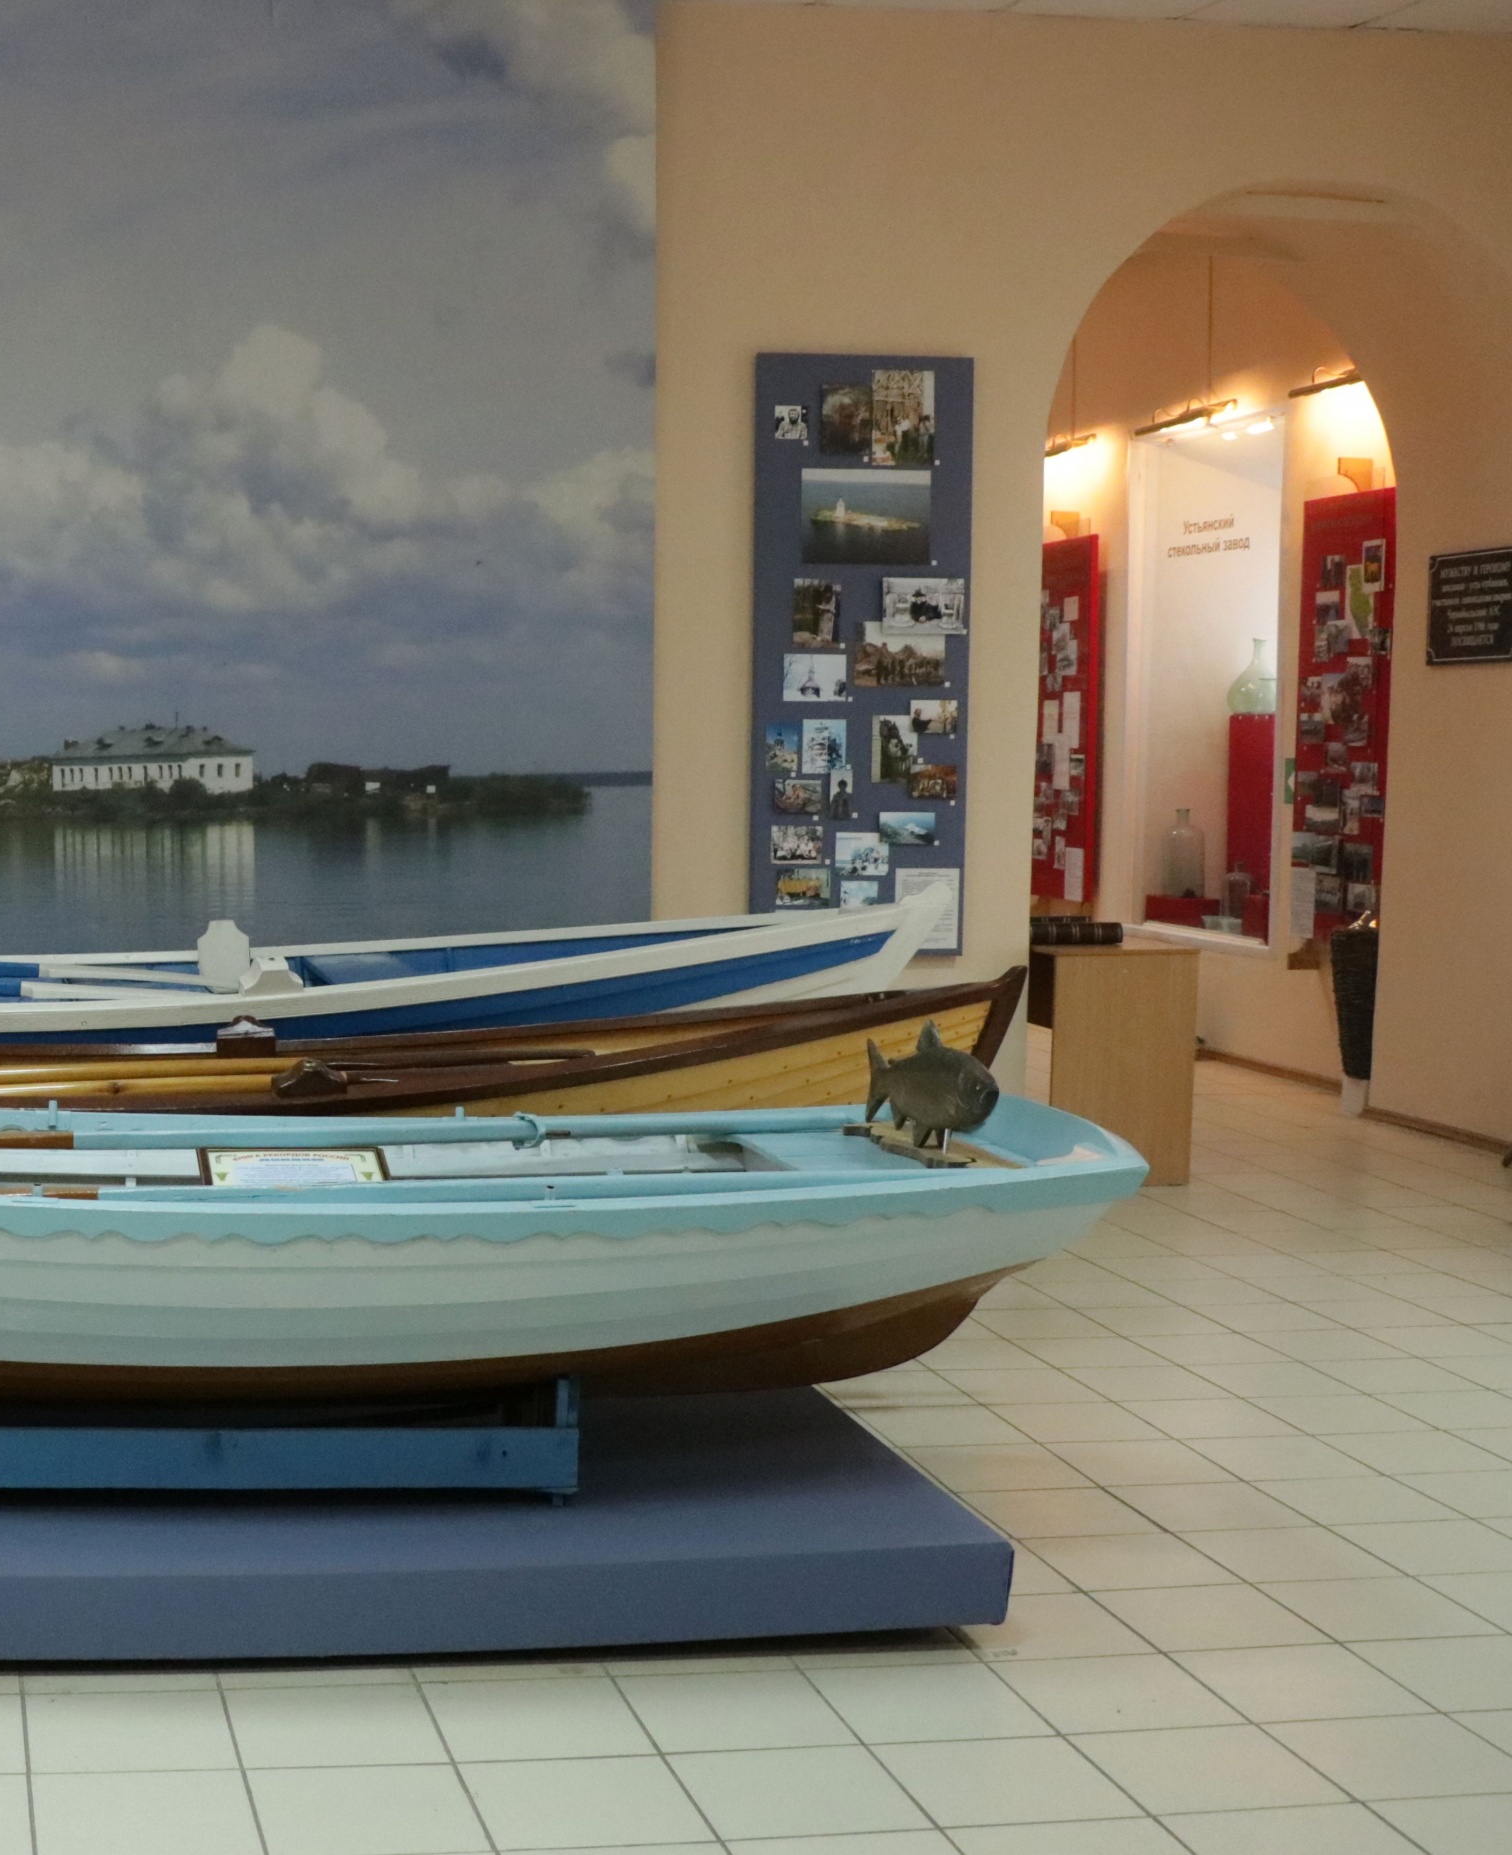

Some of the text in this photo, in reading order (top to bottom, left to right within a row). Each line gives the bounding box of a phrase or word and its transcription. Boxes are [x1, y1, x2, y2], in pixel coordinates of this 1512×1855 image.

[1182, 513, 1235, 535] Устьянский
[1167, 536, 1251, 558] стекольный завод
